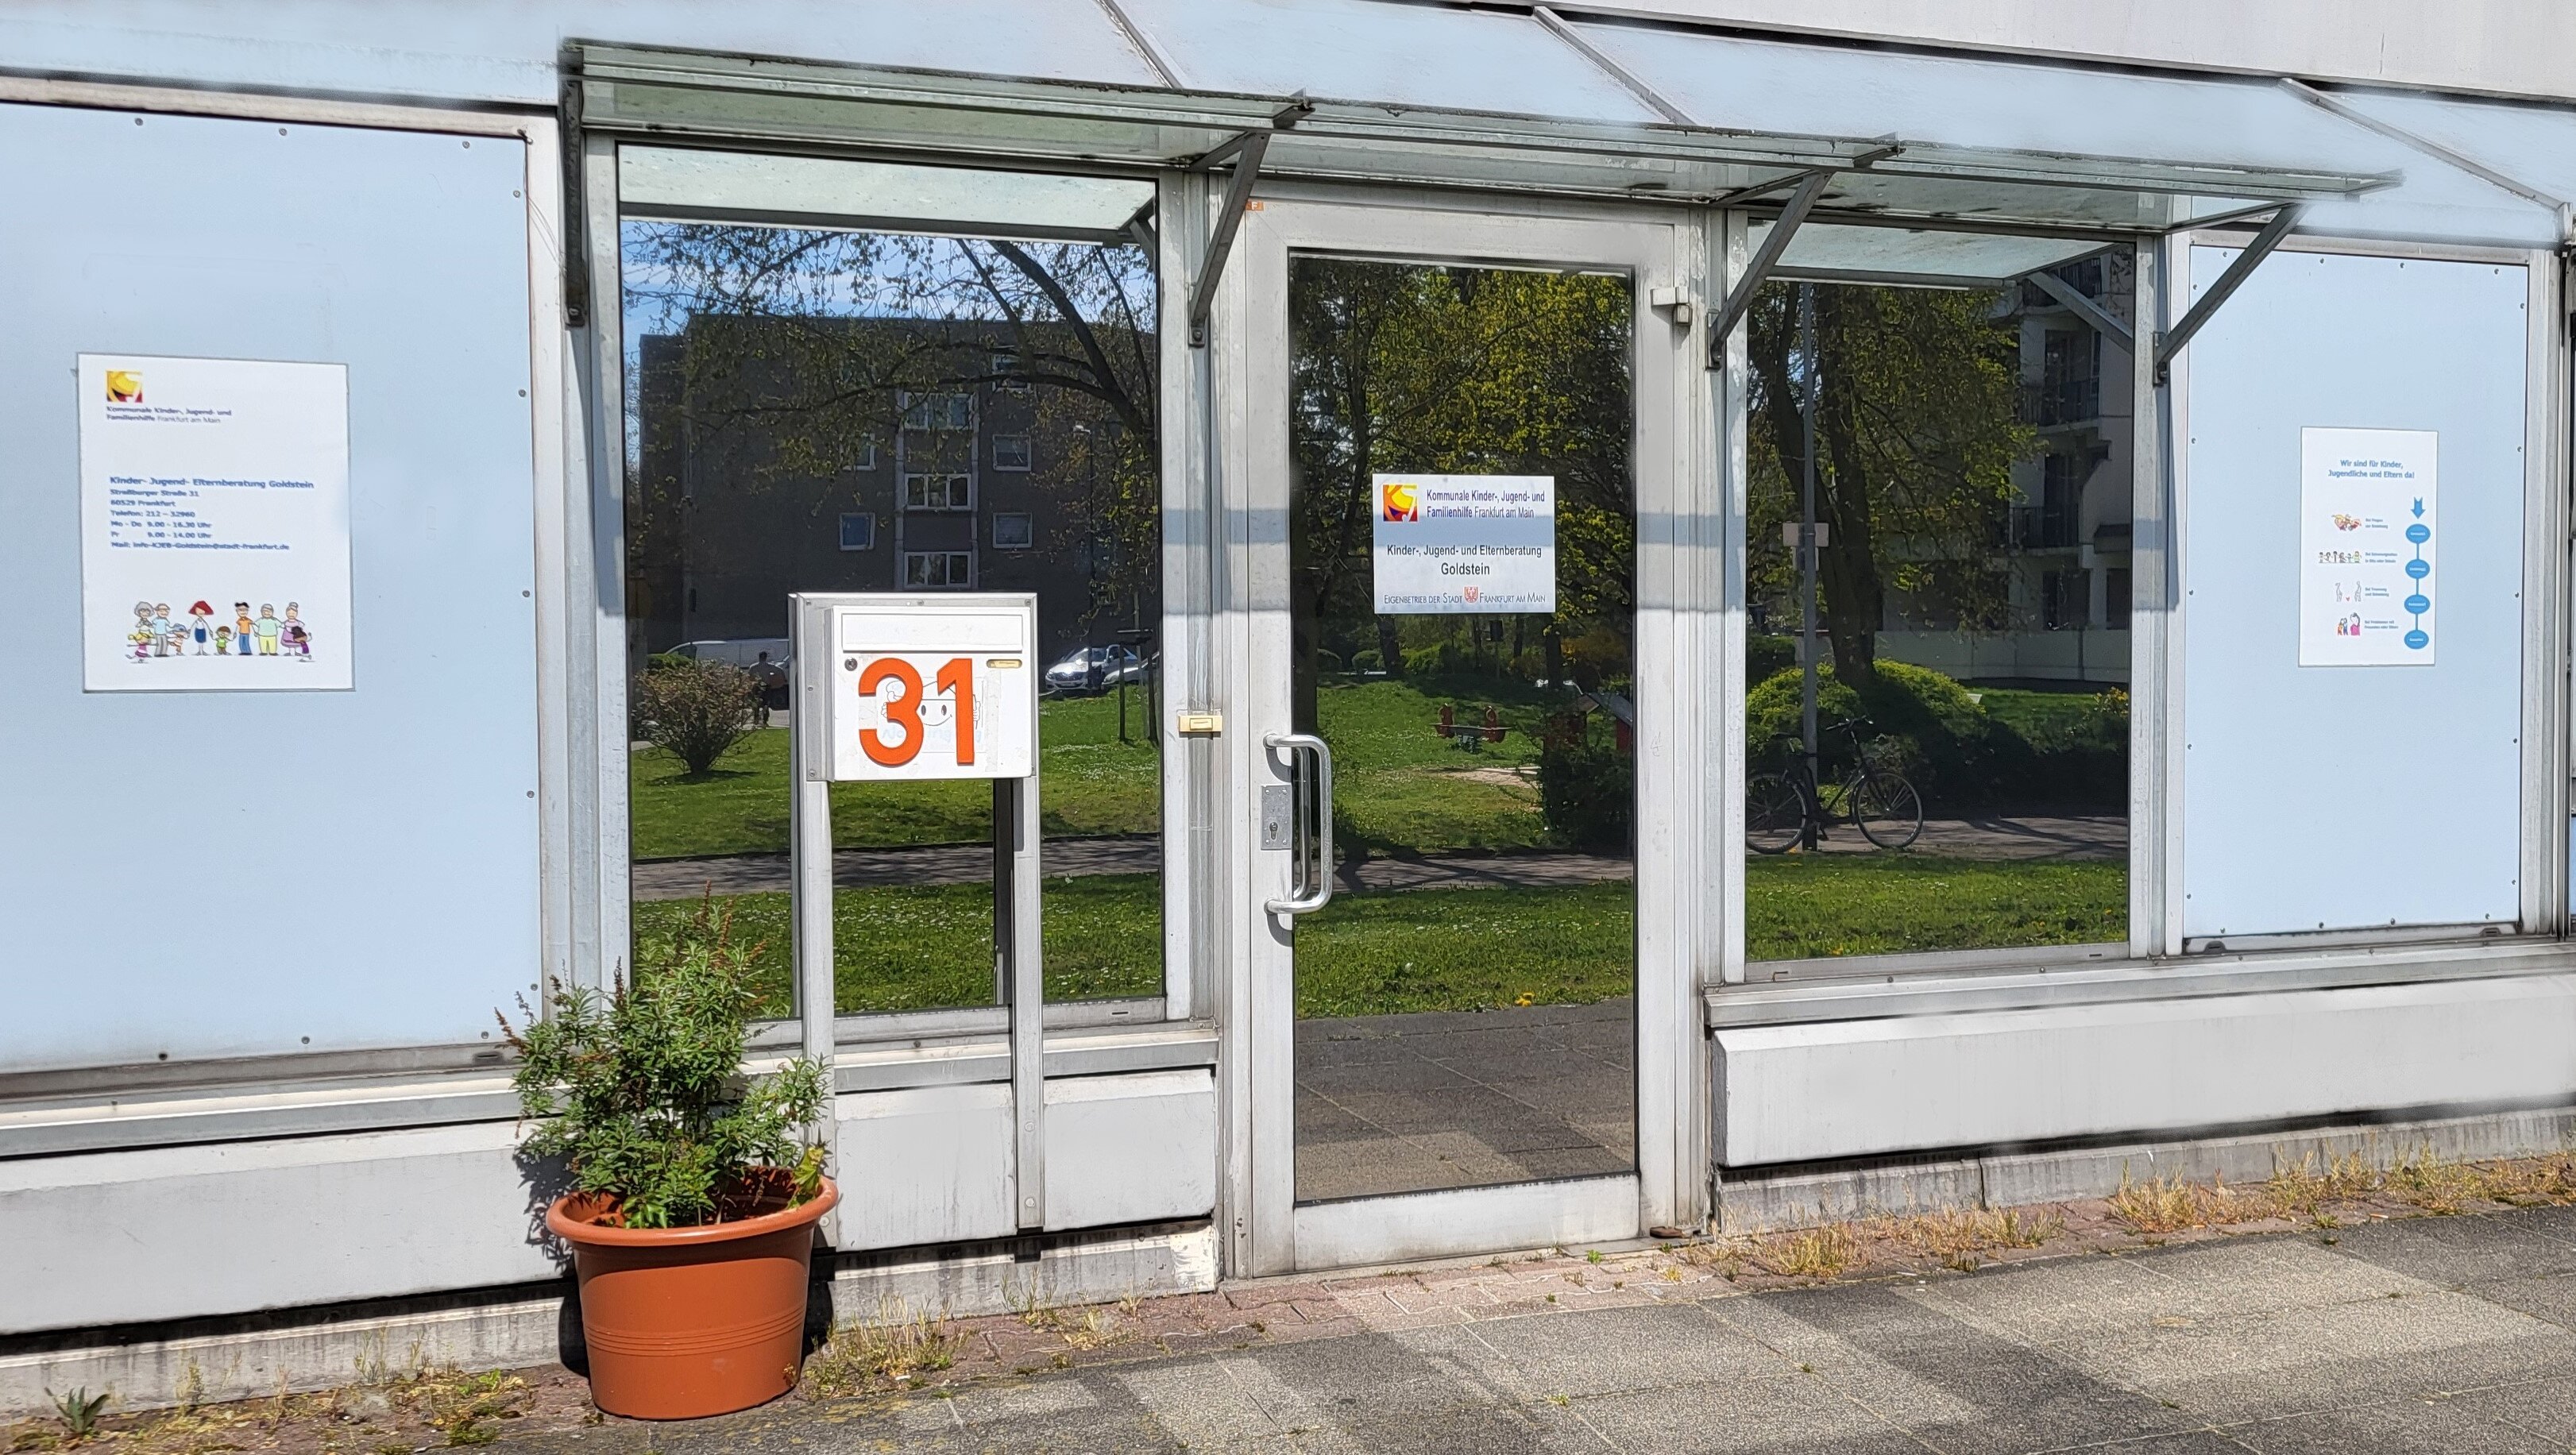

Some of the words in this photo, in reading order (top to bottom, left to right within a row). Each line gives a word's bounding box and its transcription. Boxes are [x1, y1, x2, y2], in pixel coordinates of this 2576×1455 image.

[2328, 470, 2367, 478] Jugendliche
[149, 477, 190, 486] Jugend-
[193, 479, 266, 488] Elternberatung
[269, 480, 314, 488] Goldstein
[1427, 489, 1469, 501] Kommunale
[1471, 490, 1499, 504] Kinder-,
[1501, 490, 1530, 504] Jugend-
[1531, 492, 1545, 502] und
[1427, 506, 1472, 518] Familienhilfe
[1474, 506, 1504, 518] Frankfurt
[1506, 509, 1516, 518] am
[1518, 507, 1534, 518] Main
[1387, 544, 1421, 557] Kinder-,
[1423, 545, 1459, 558] Jugend-
[1461, 546, 1477, 556] und
[1479, 545, 1542, 558] Elternberatung
[1441, 562, 1490, 575] Goldstein
[859, 657, 975, 768] 31
